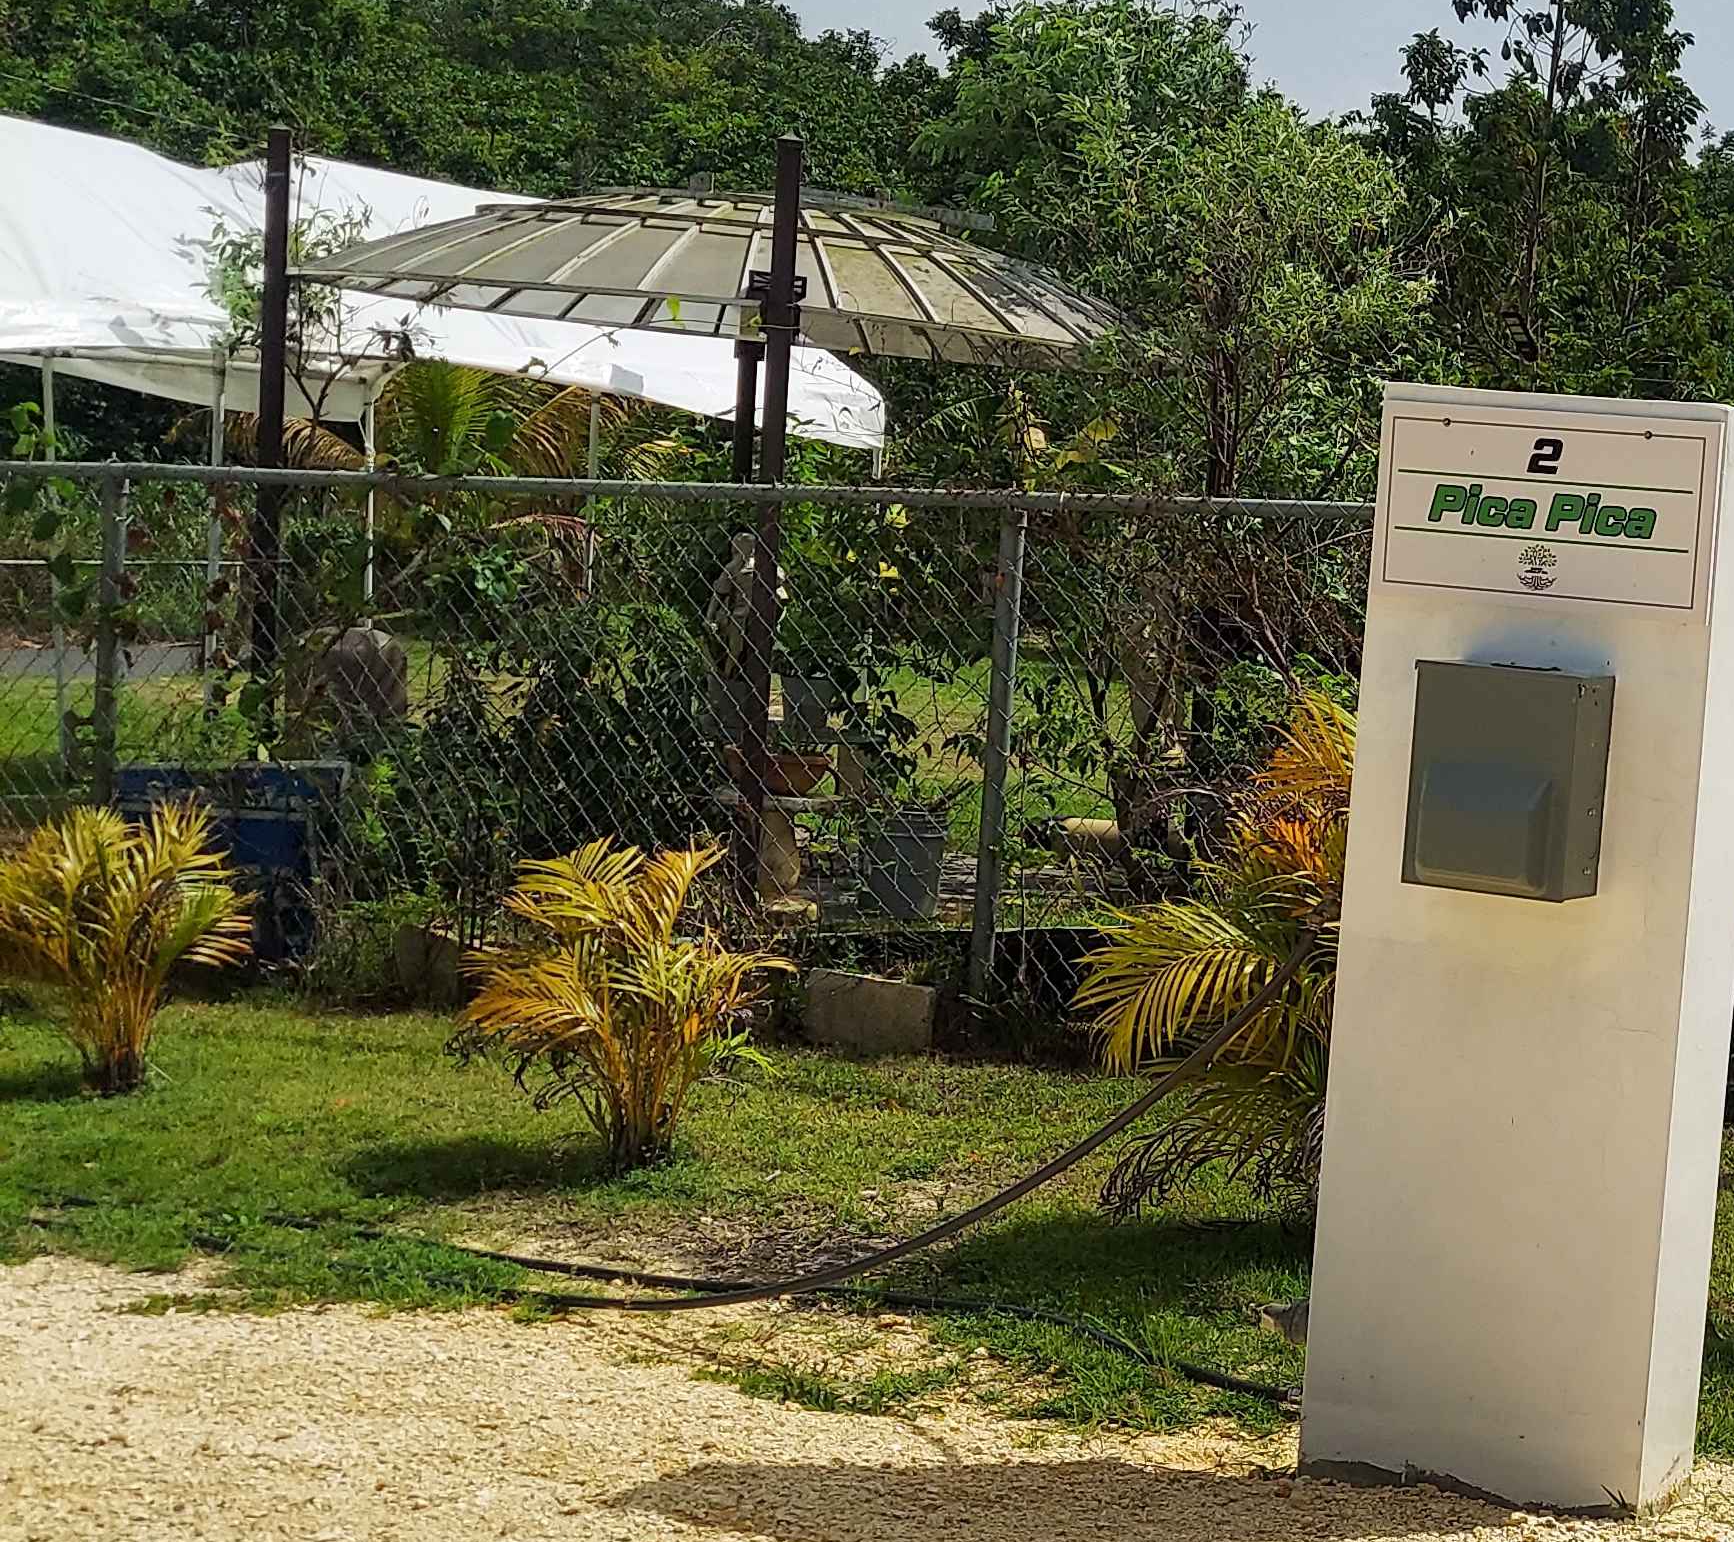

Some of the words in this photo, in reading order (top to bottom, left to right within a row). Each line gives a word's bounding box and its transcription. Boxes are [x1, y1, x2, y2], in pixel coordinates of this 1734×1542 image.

[1526, 437, 1563, 474] 2
[1428, 484, 1537, 529] Pica
[1545, 493, 1657, 539] Pica
